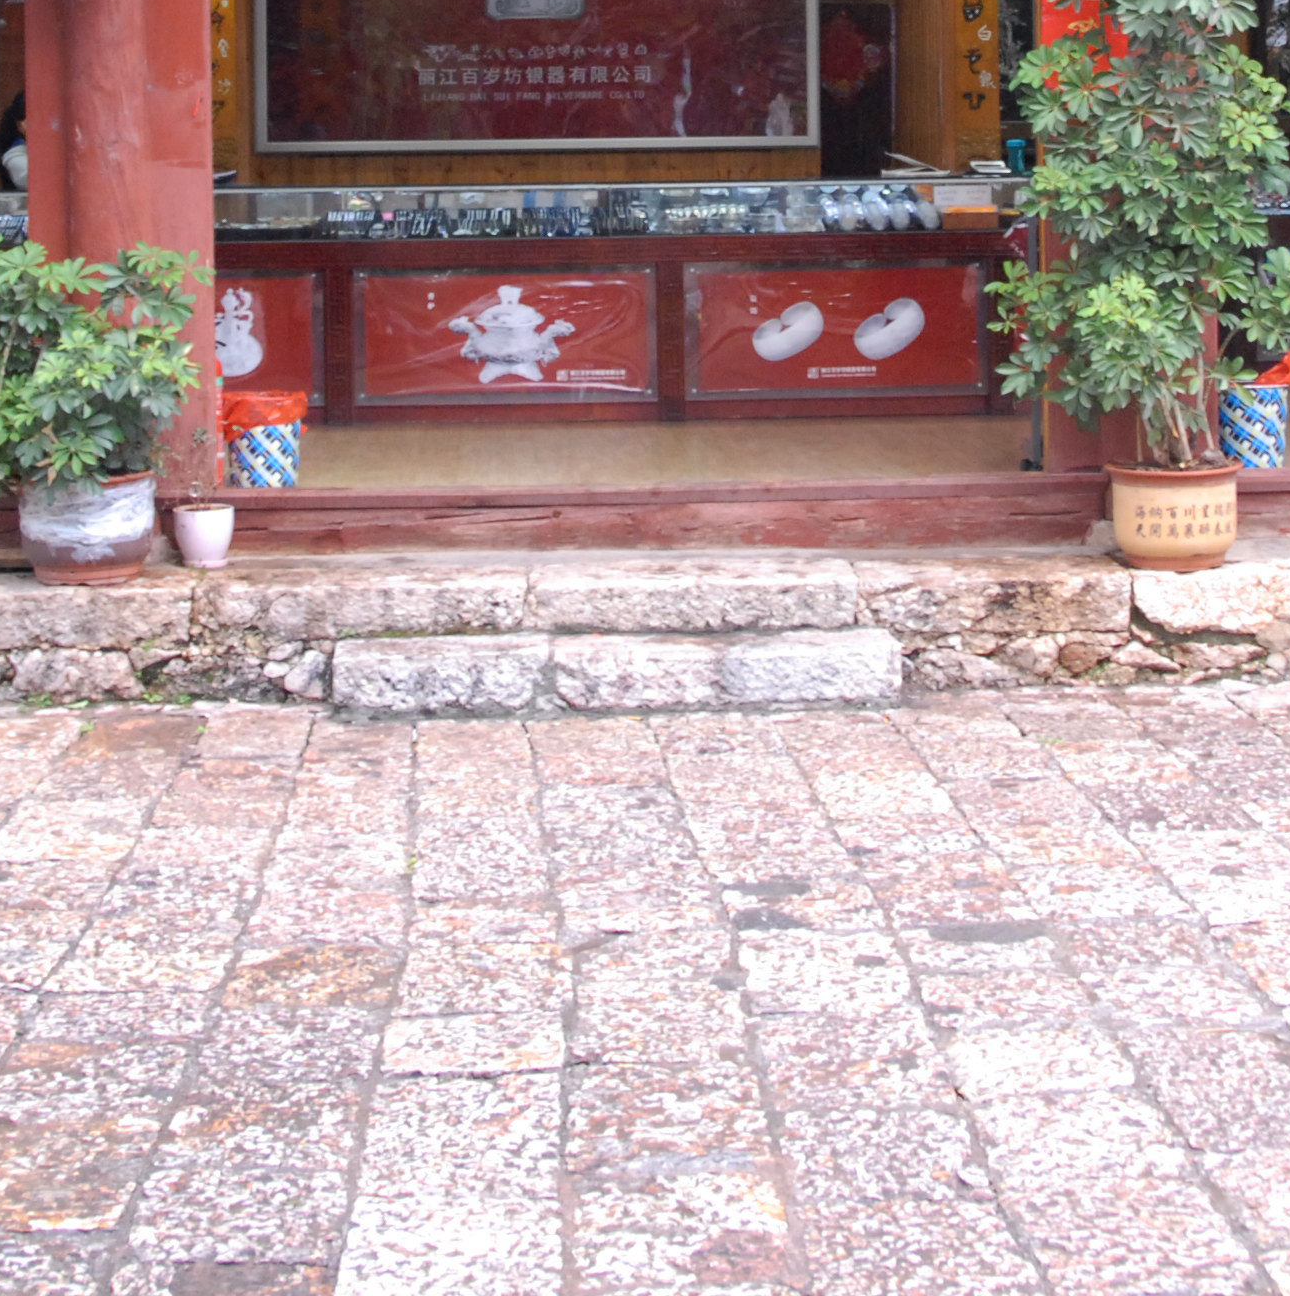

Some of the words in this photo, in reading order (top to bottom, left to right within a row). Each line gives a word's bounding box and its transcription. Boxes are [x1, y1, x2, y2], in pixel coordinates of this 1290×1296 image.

[418, 65, 653, 87] 丽江百岁坊银器有限公司
